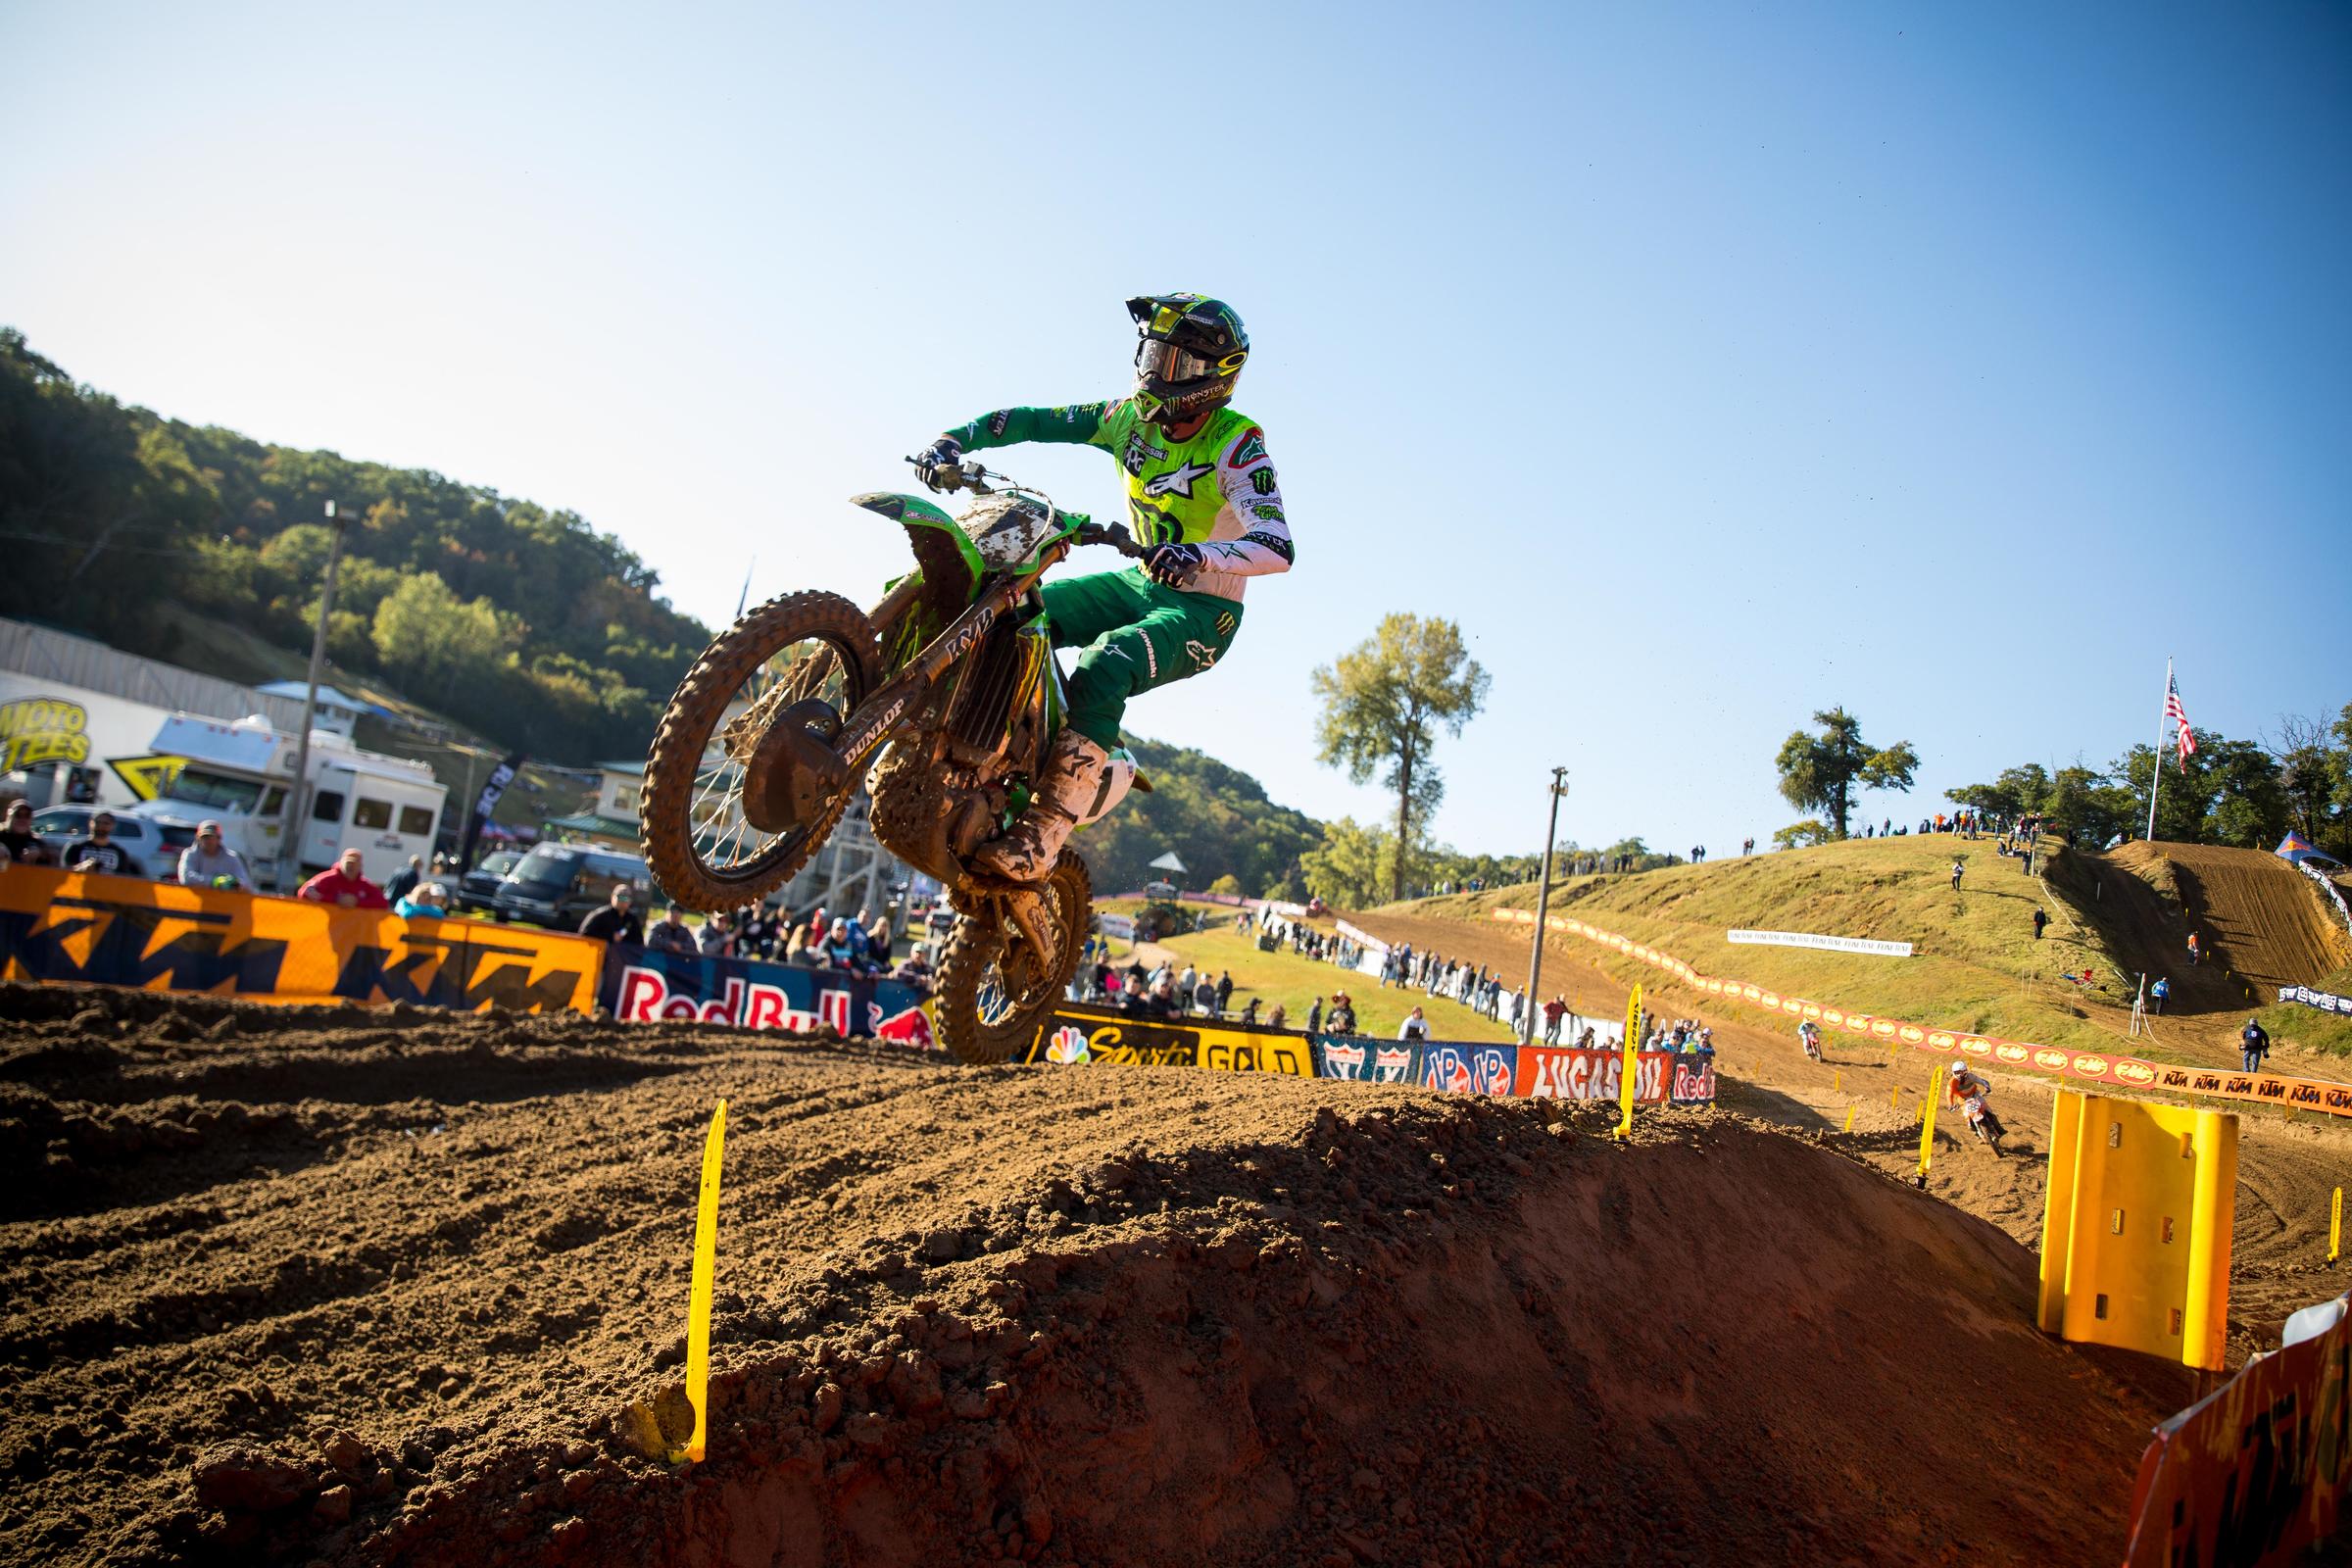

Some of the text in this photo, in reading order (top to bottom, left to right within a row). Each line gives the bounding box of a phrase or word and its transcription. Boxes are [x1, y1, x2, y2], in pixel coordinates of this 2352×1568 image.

[2, 732, 89, 772] TEES
[844, 698, 905, 765] DUNLOP
[332, 934, 581, 1013] KTM
[1532, 1054, 1622, 1100] LUCAS
[2073, 1059, 2109, 1073] FMF
[2115, 1064, 2155, 1081] FMF
[2163, 1071, 2188, 1087] KTM
[2194, 1074, 2221, 1092] KTM
[2225, 1077, 2254, 1095] KTM
[2258, 1080, 2286, 1099] KTM
[2290, 1084, 2322, 1104] KTM
